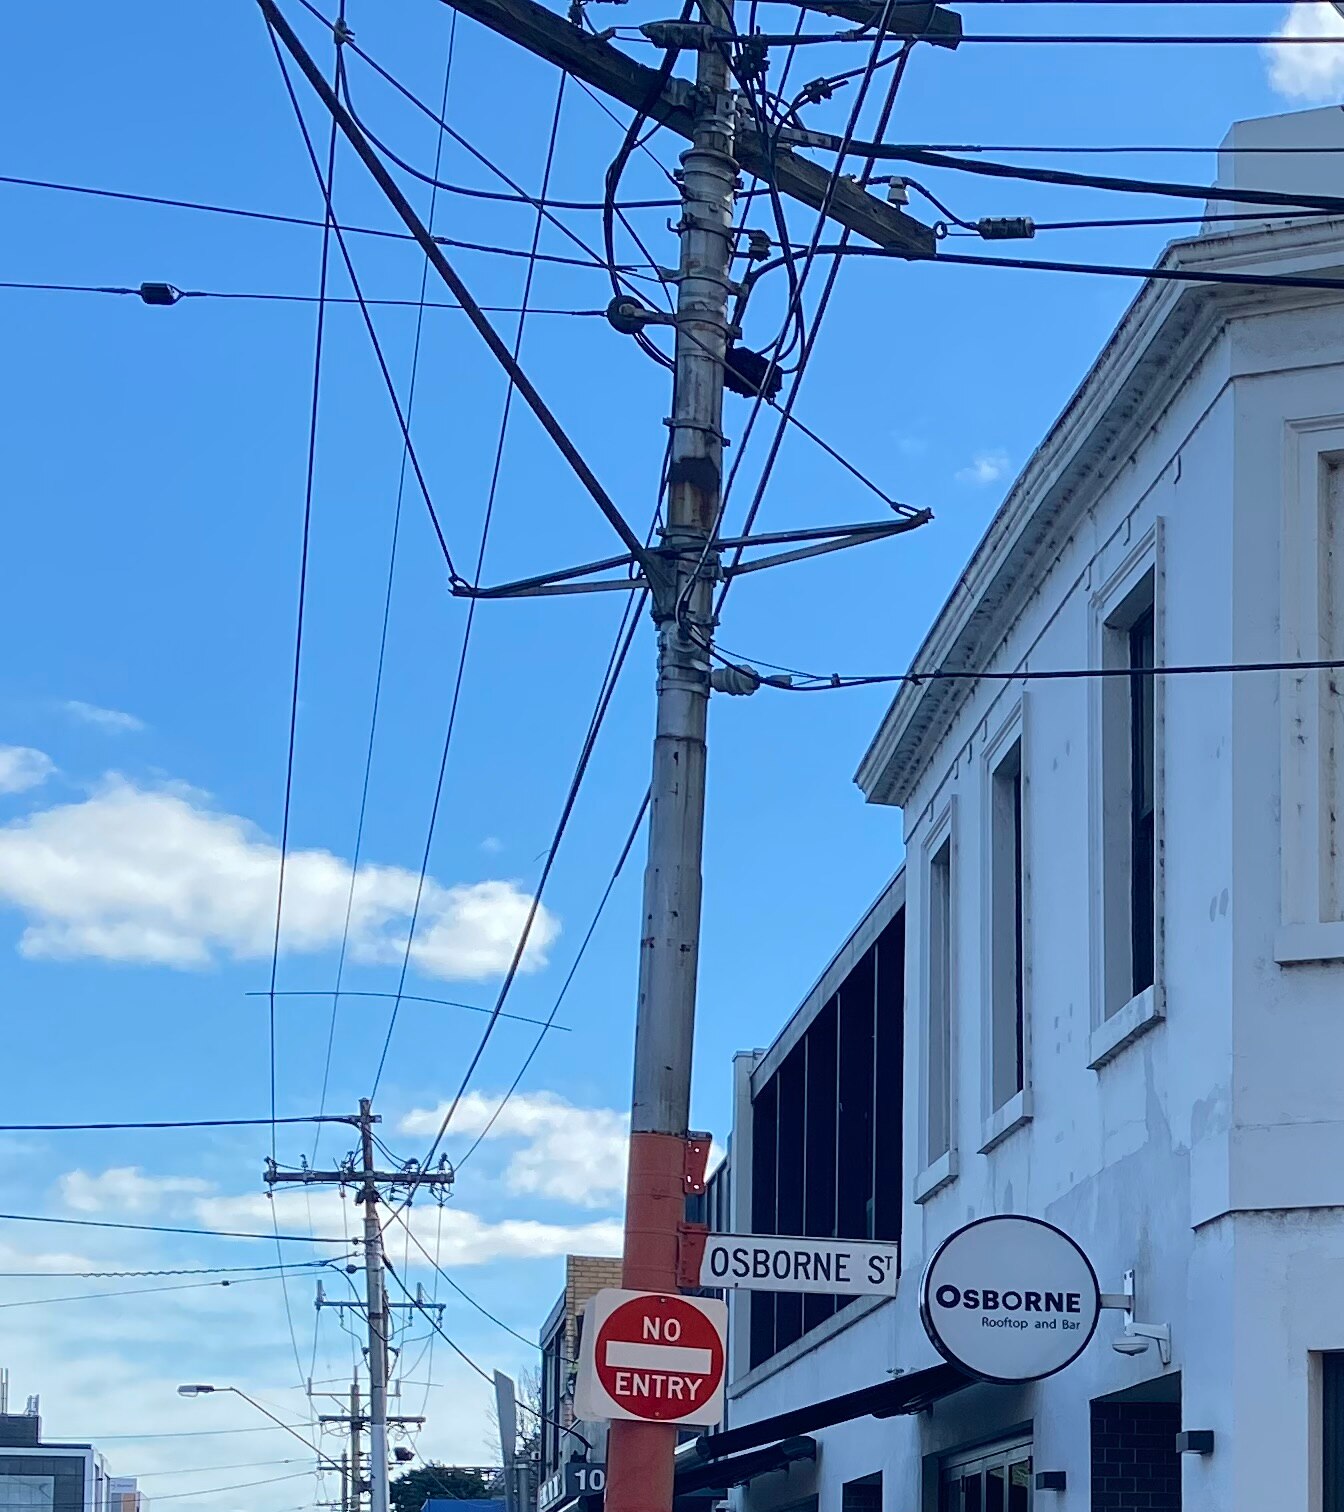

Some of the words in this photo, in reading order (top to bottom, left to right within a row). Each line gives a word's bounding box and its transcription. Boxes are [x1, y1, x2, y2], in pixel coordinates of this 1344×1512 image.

[710, 1247, 851, 1282] OSBORNE
[935, 1284, 1081, 1313] OSBORNE
[643, 1316, 681, 1342] NO
[981, 1316, 1029, 1331] Rooftop
[1034, 1318, 1057, 1330] and
[1062, 1319, 1081, 1330] Bar
[615, 1371, 703, 1401] ENTRY
